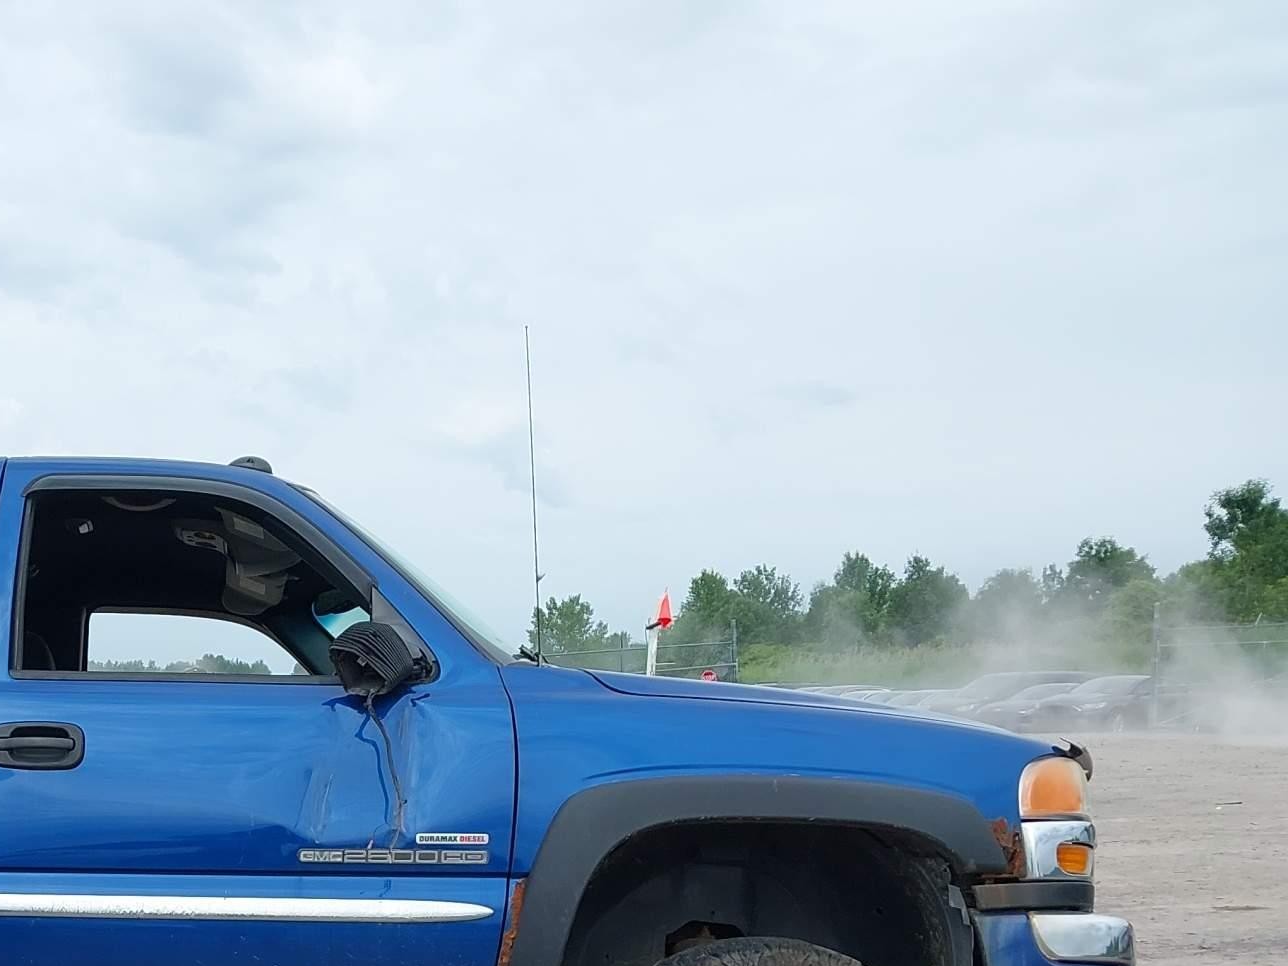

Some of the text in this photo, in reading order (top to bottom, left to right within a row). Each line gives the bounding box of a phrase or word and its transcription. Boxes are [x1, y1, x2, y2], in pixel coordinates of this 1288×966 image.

[418, 834, 487, 843] DURAMAX DIESEL
[299, 849, 343, 862] GMC
